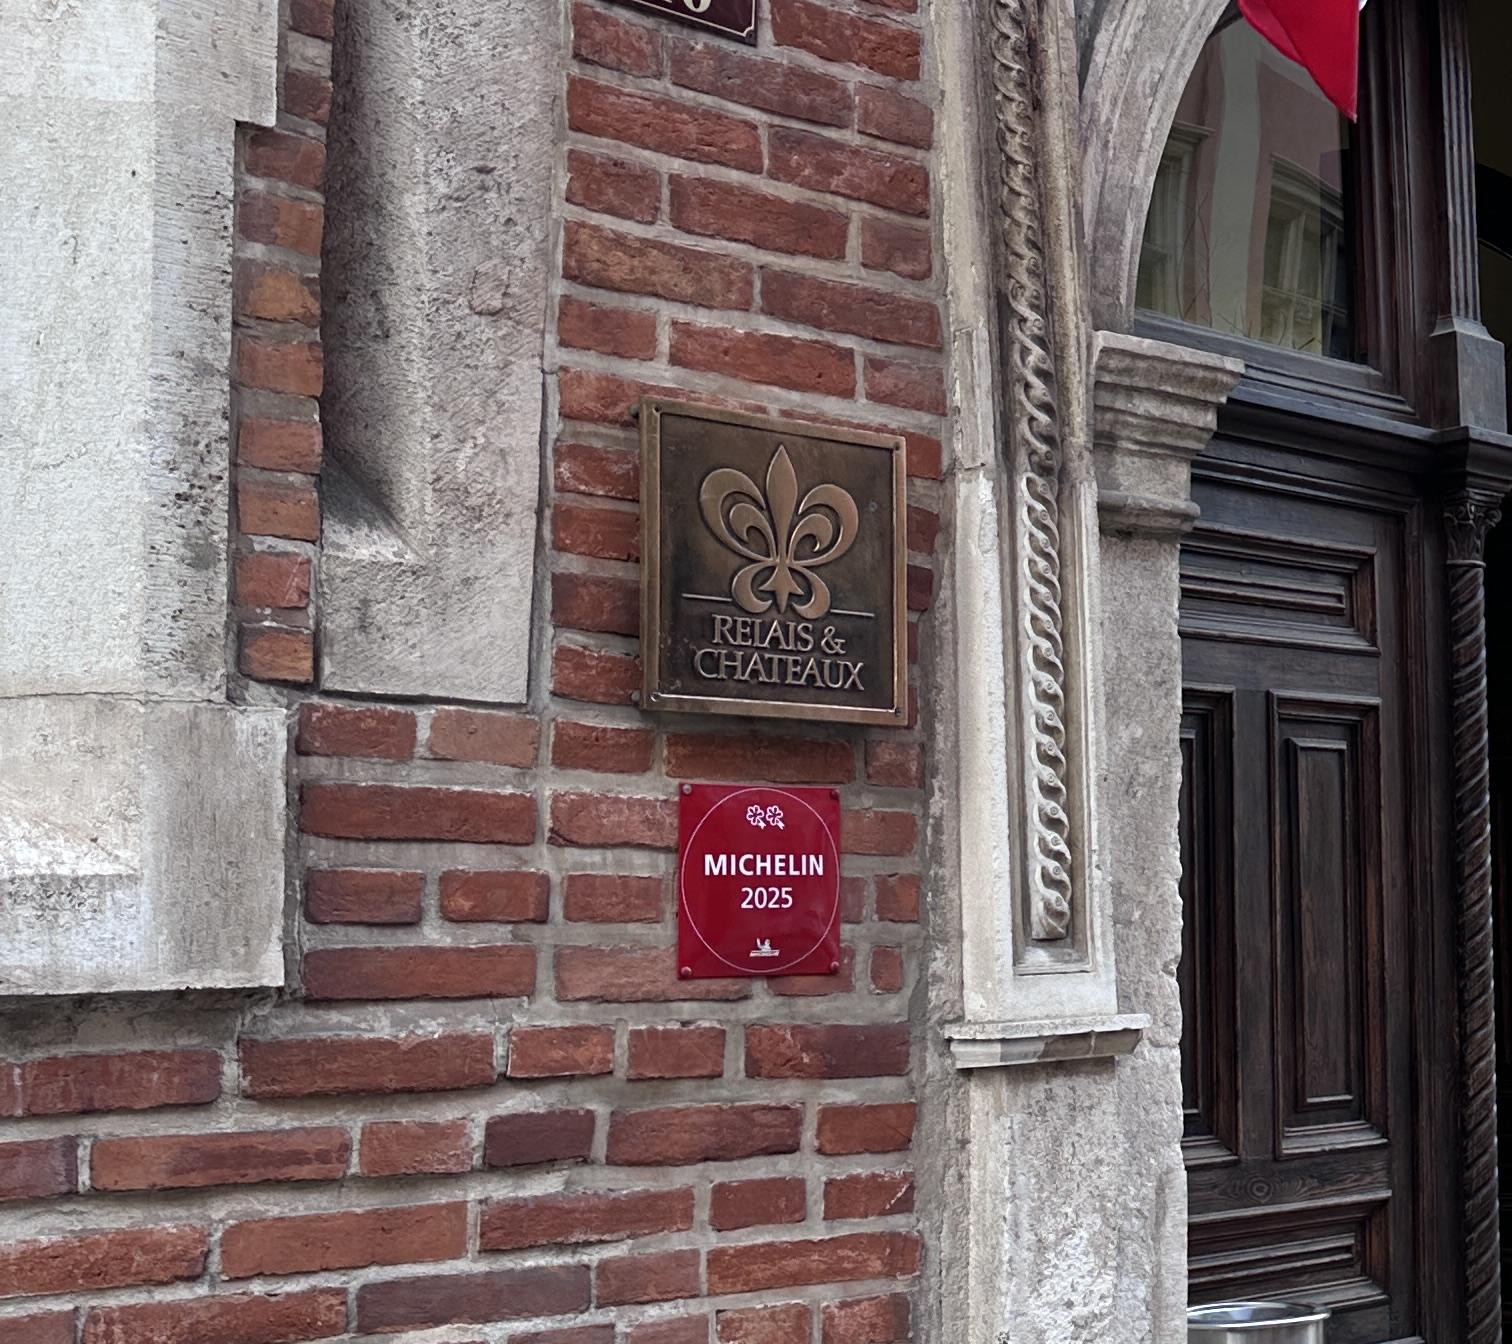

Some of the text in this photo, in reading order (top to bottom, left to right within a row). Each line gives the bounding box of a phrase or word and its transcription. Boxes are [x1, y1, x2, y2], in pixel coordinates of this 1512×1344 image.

[711, 613, 846, 655] RELAIS &
[703, 853, 825, 877] MICHELIN
[740, 886, 793, 909] 2025
